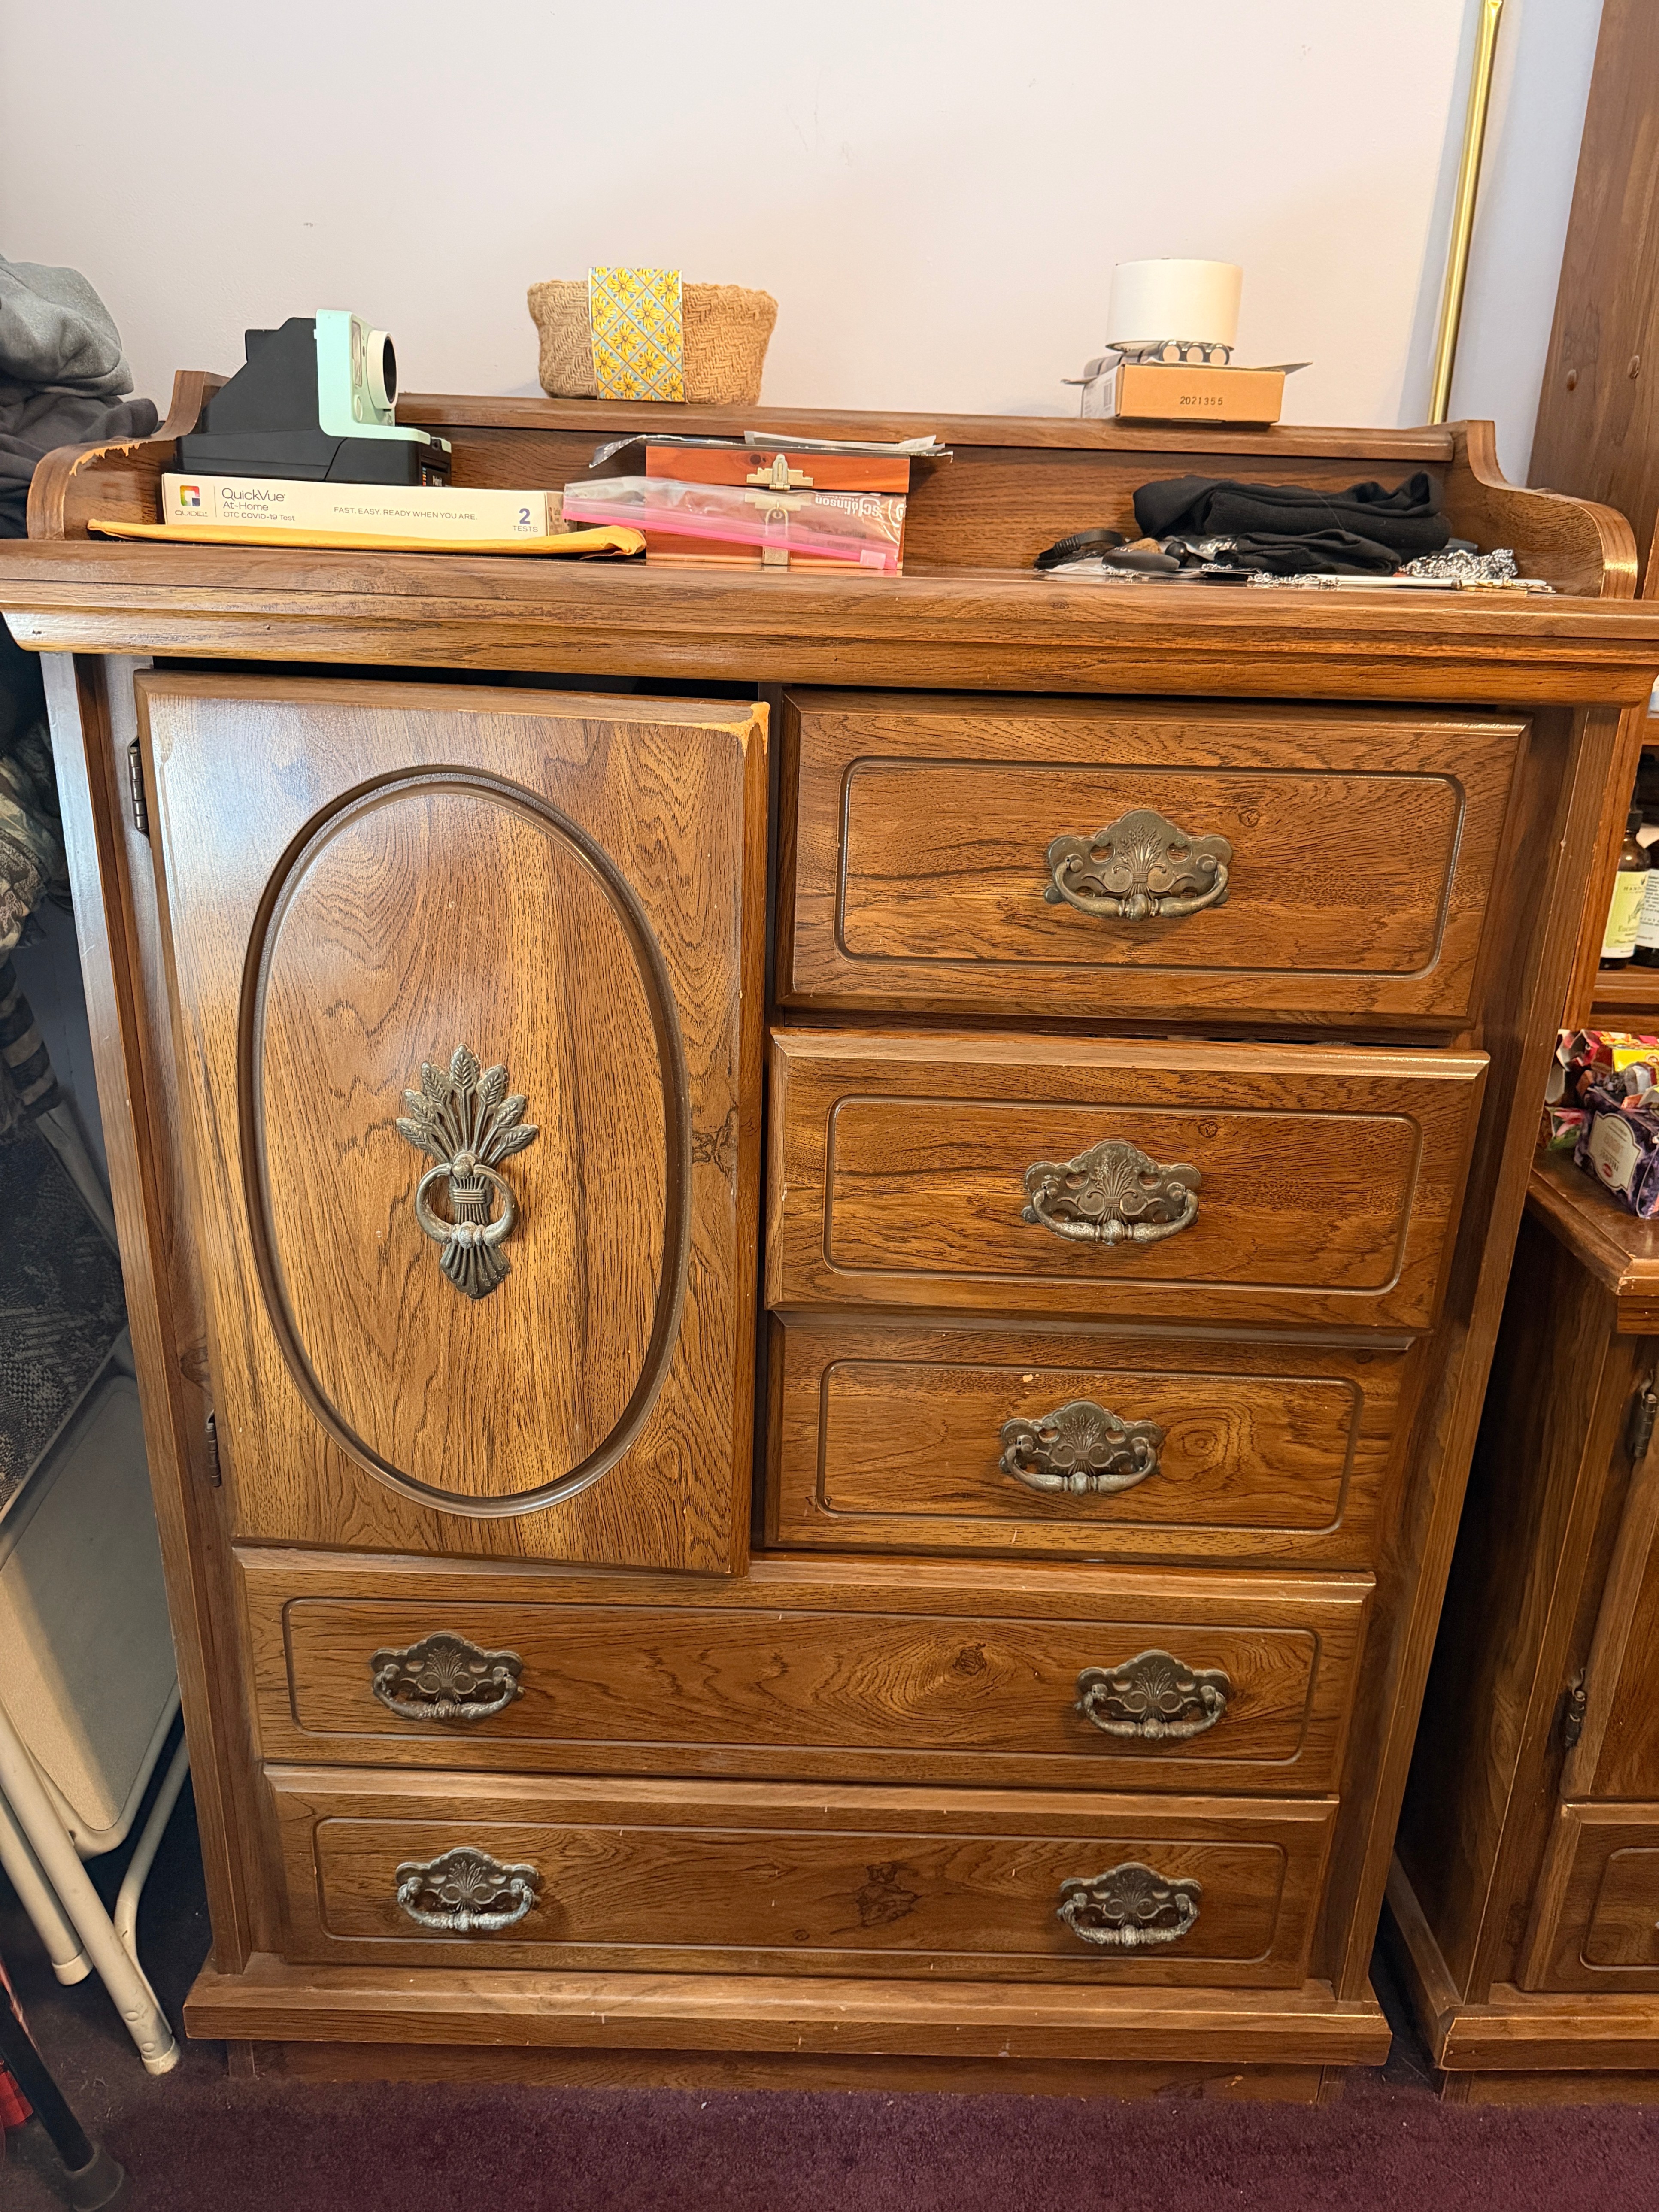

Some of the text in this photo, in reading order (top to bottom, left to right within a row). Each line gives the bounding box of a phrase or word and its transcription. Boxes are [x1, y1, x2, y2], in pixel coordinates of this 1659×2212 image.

[1179, 396, 1223, 406] 2021355
[221, 488, 285, 502] QuickVue
[223, 501, 269, 511] At-Home
[241, 512, 278, 520] COVID-19
[519, 508, 531, 524] 2
